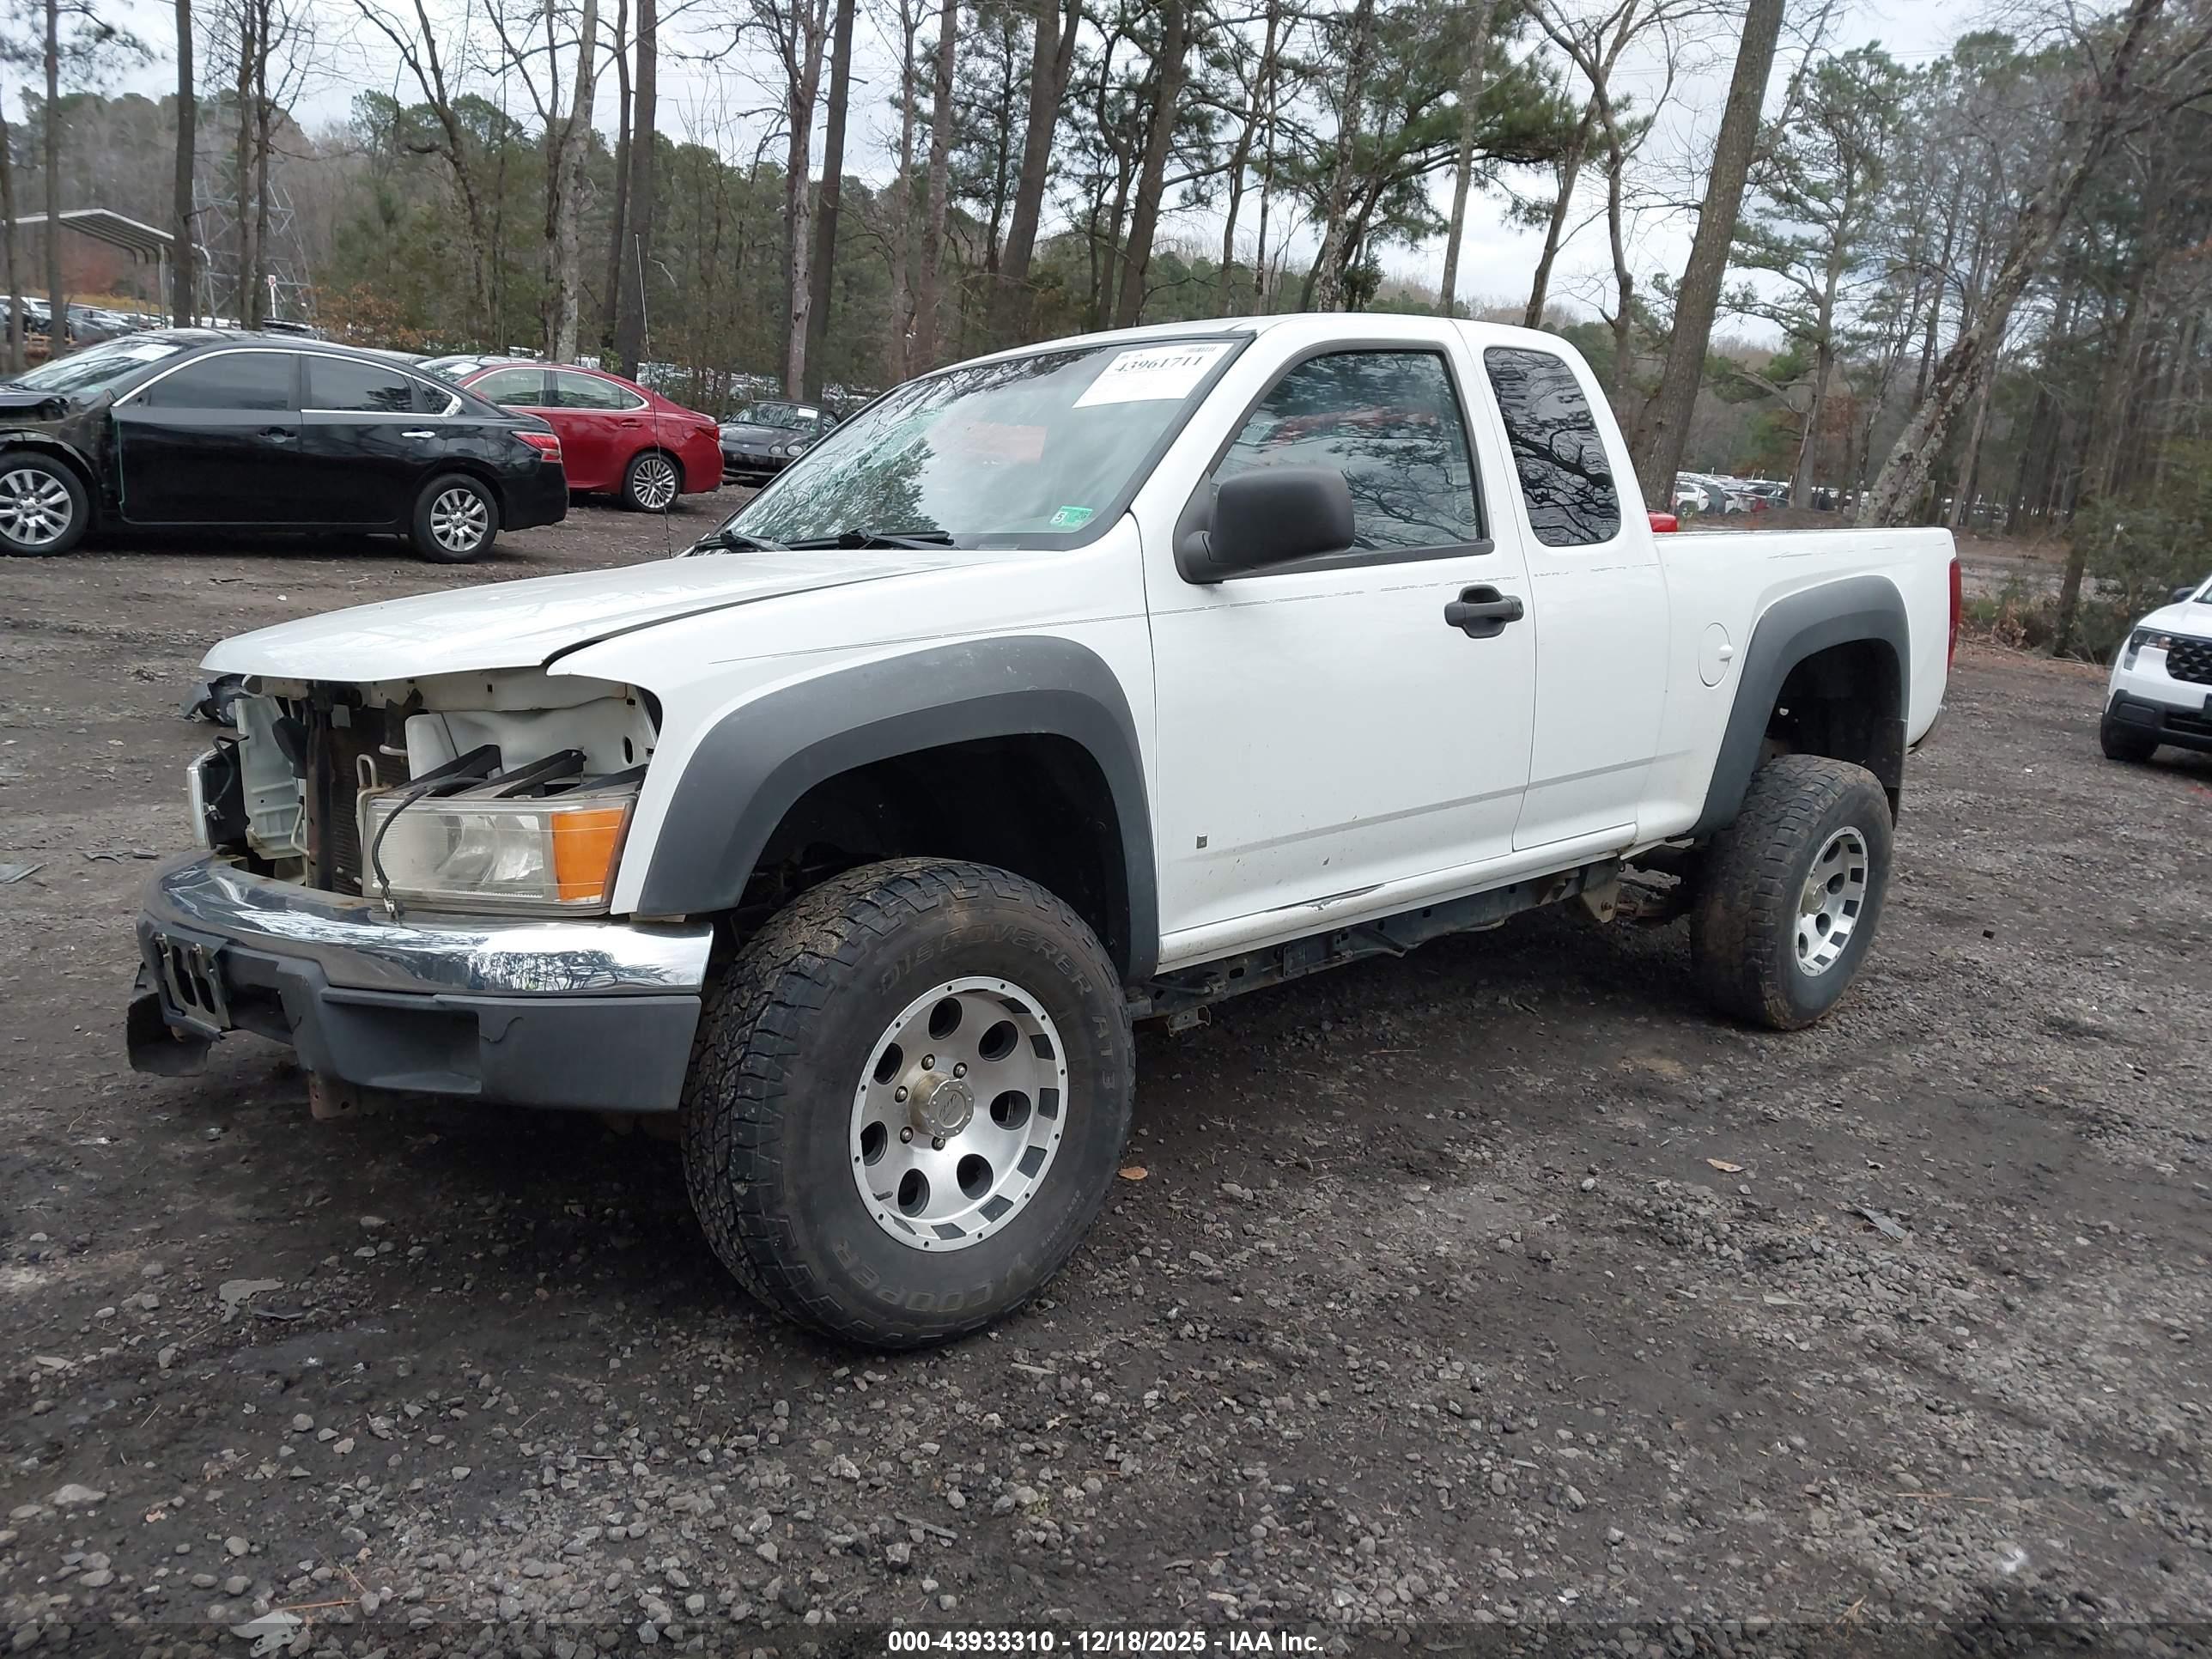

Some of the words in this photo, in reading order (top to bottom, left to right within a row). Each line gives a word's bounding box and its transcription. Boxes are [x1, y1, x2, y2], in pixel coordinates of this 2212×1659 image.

[1115, 356, 1204, 372] 43961711
[880, 923, 1093, 996] DISCOVERER
[831, 1237, 995, 1312] COOPER
